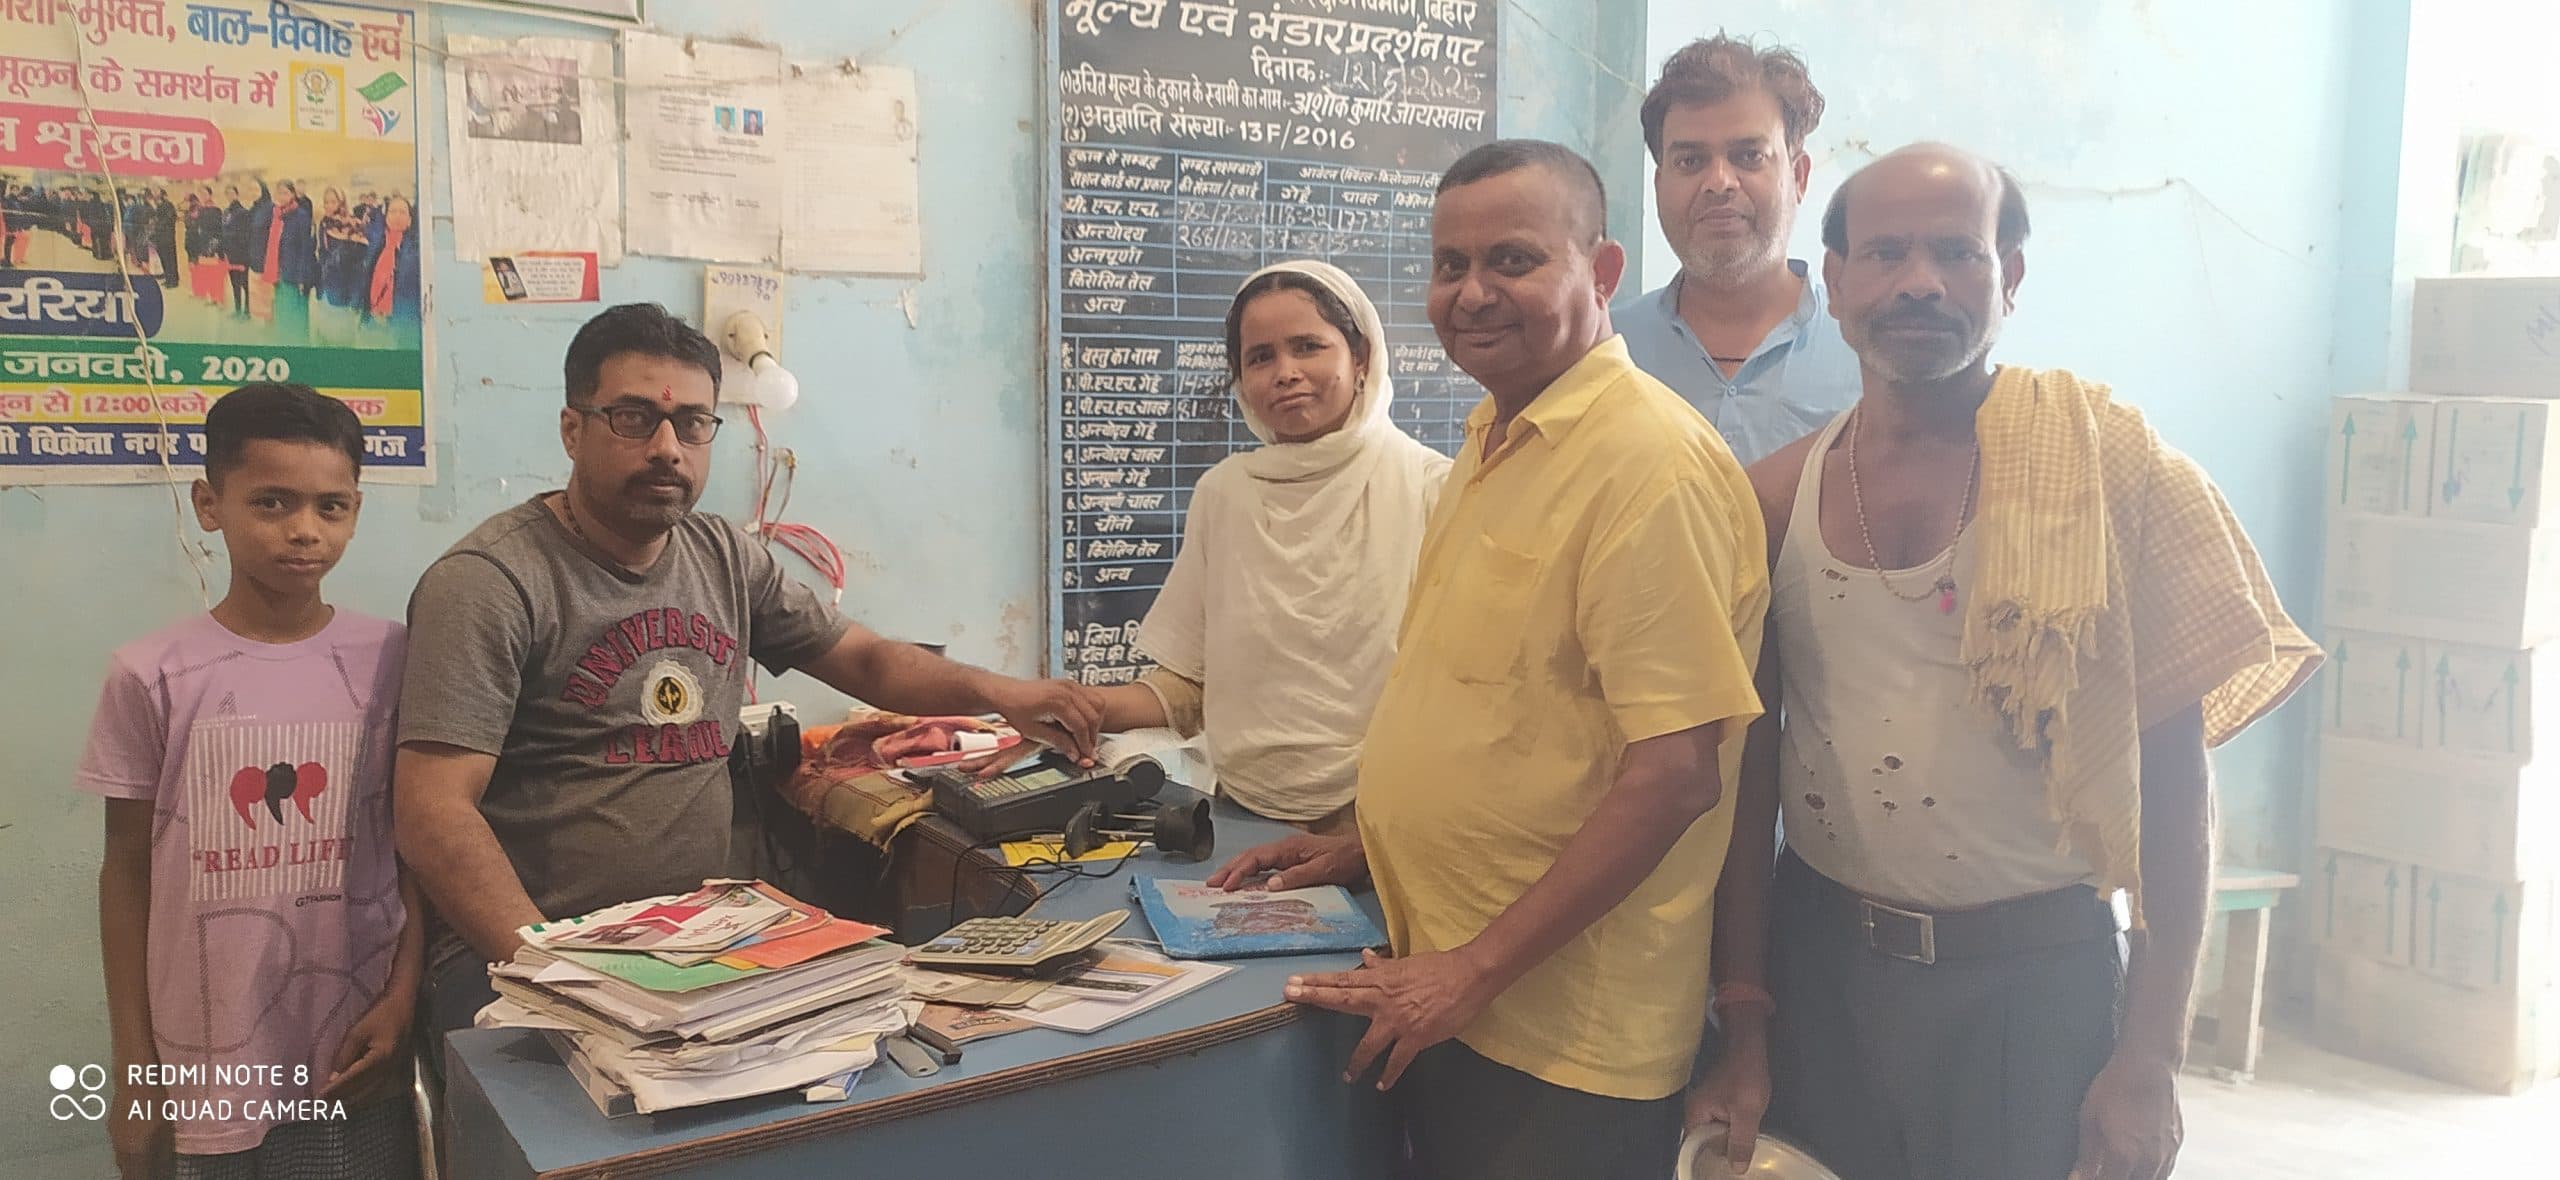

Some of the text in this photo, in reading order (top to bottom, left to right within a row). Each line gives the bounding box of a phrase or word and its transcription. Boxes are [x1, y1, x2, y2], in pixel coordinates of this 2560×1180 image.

[361, 14, 402, 61] एवं
[1065, 0, 1484, 66] मूल्य एवं भंडार प्रदर्शन पट
[88, 57, 124, 93] के
[133, 66, 239, 105] समर्थन
[249, 71, 279, 108] में
[202, 356, 290, 382] 2020
[84, 396, 151, 413] 12:00
